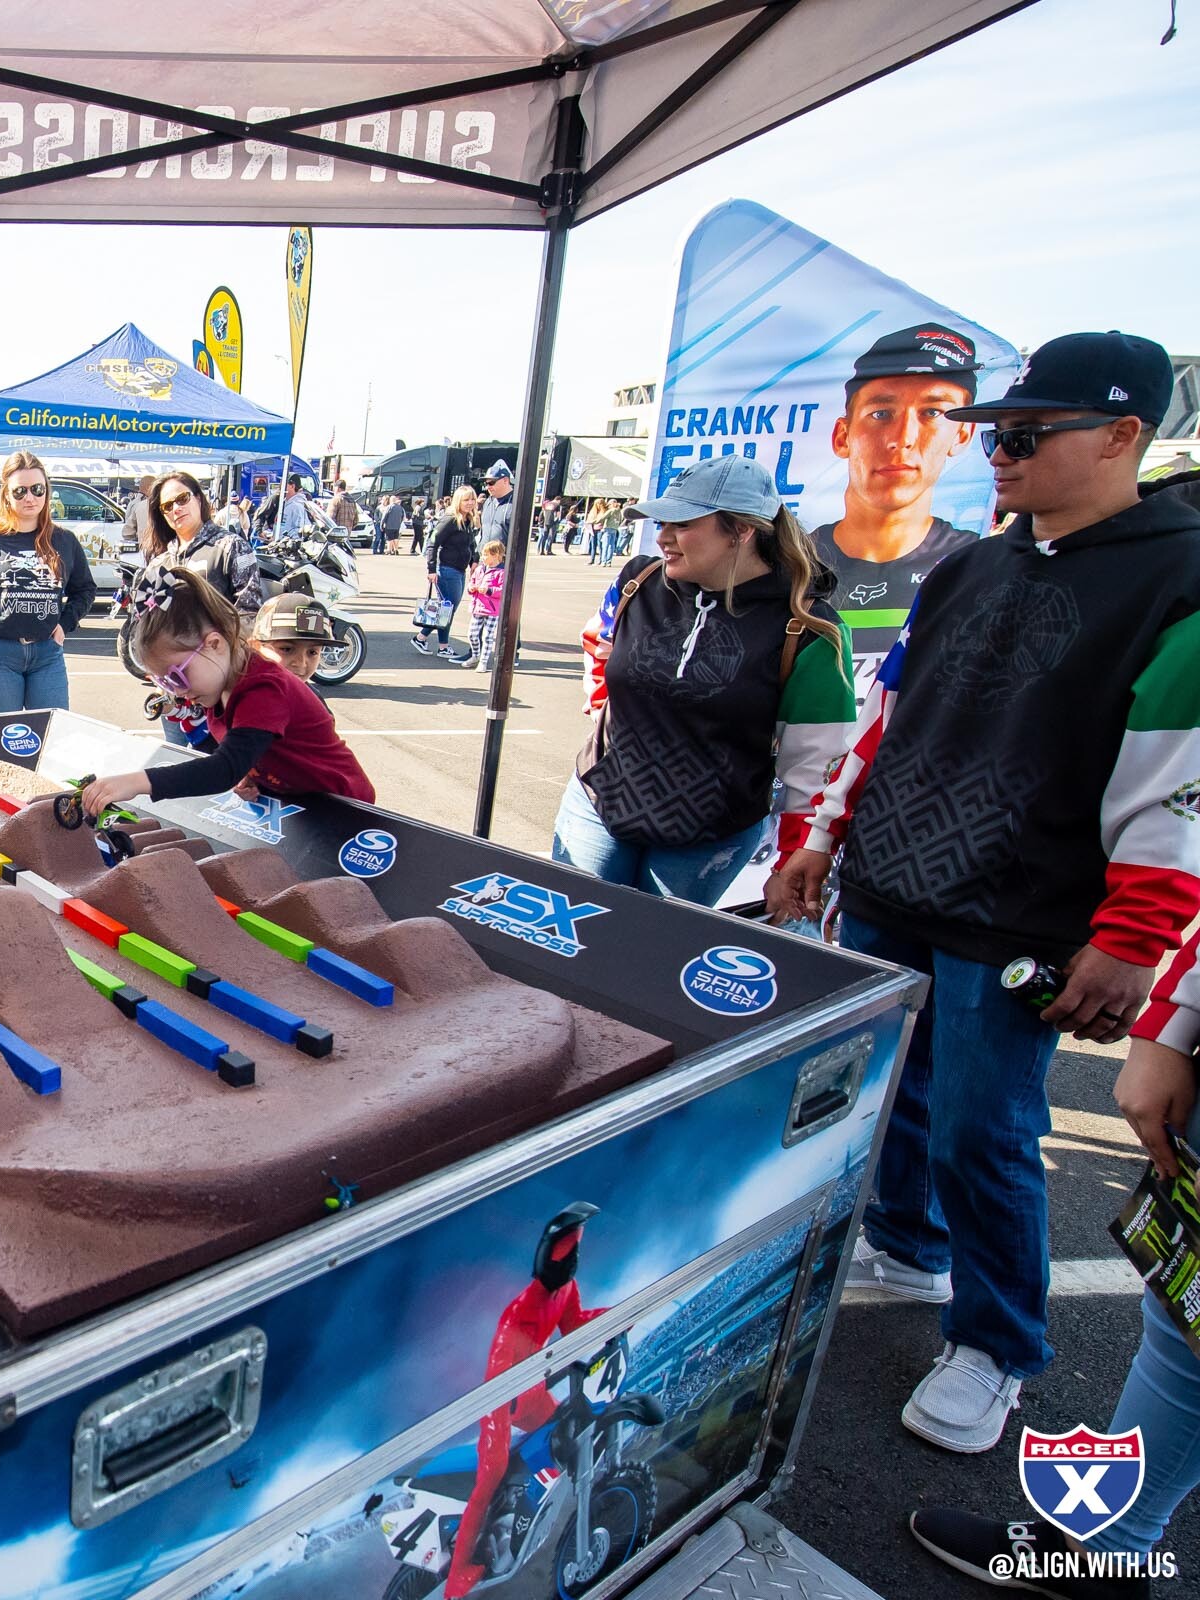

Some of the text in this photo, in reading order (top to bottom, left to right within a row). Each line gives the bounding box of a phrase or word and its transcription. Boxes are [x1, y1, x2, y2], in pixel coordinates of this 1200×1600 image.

[919, 342, 965, 366] Kawasaki
[5, 407, 267, 441] CaliforniaMotorcyclist.com
[666, 403, 820, 438] CRANK IT
[8, 738, 35, 746] SPIN
[347, 847, 385, 866] SPIN
[443, 899, 579, 955] SUPERCROSS
[484, 883, 602, 941] SX
[694, 970, 759, 1000] SPIN
[1122, 1192, 1153, 1239] INTRODUCING
[595, 1350, 622, 1396] 4
[390, 1508, 438, 1561] 4
